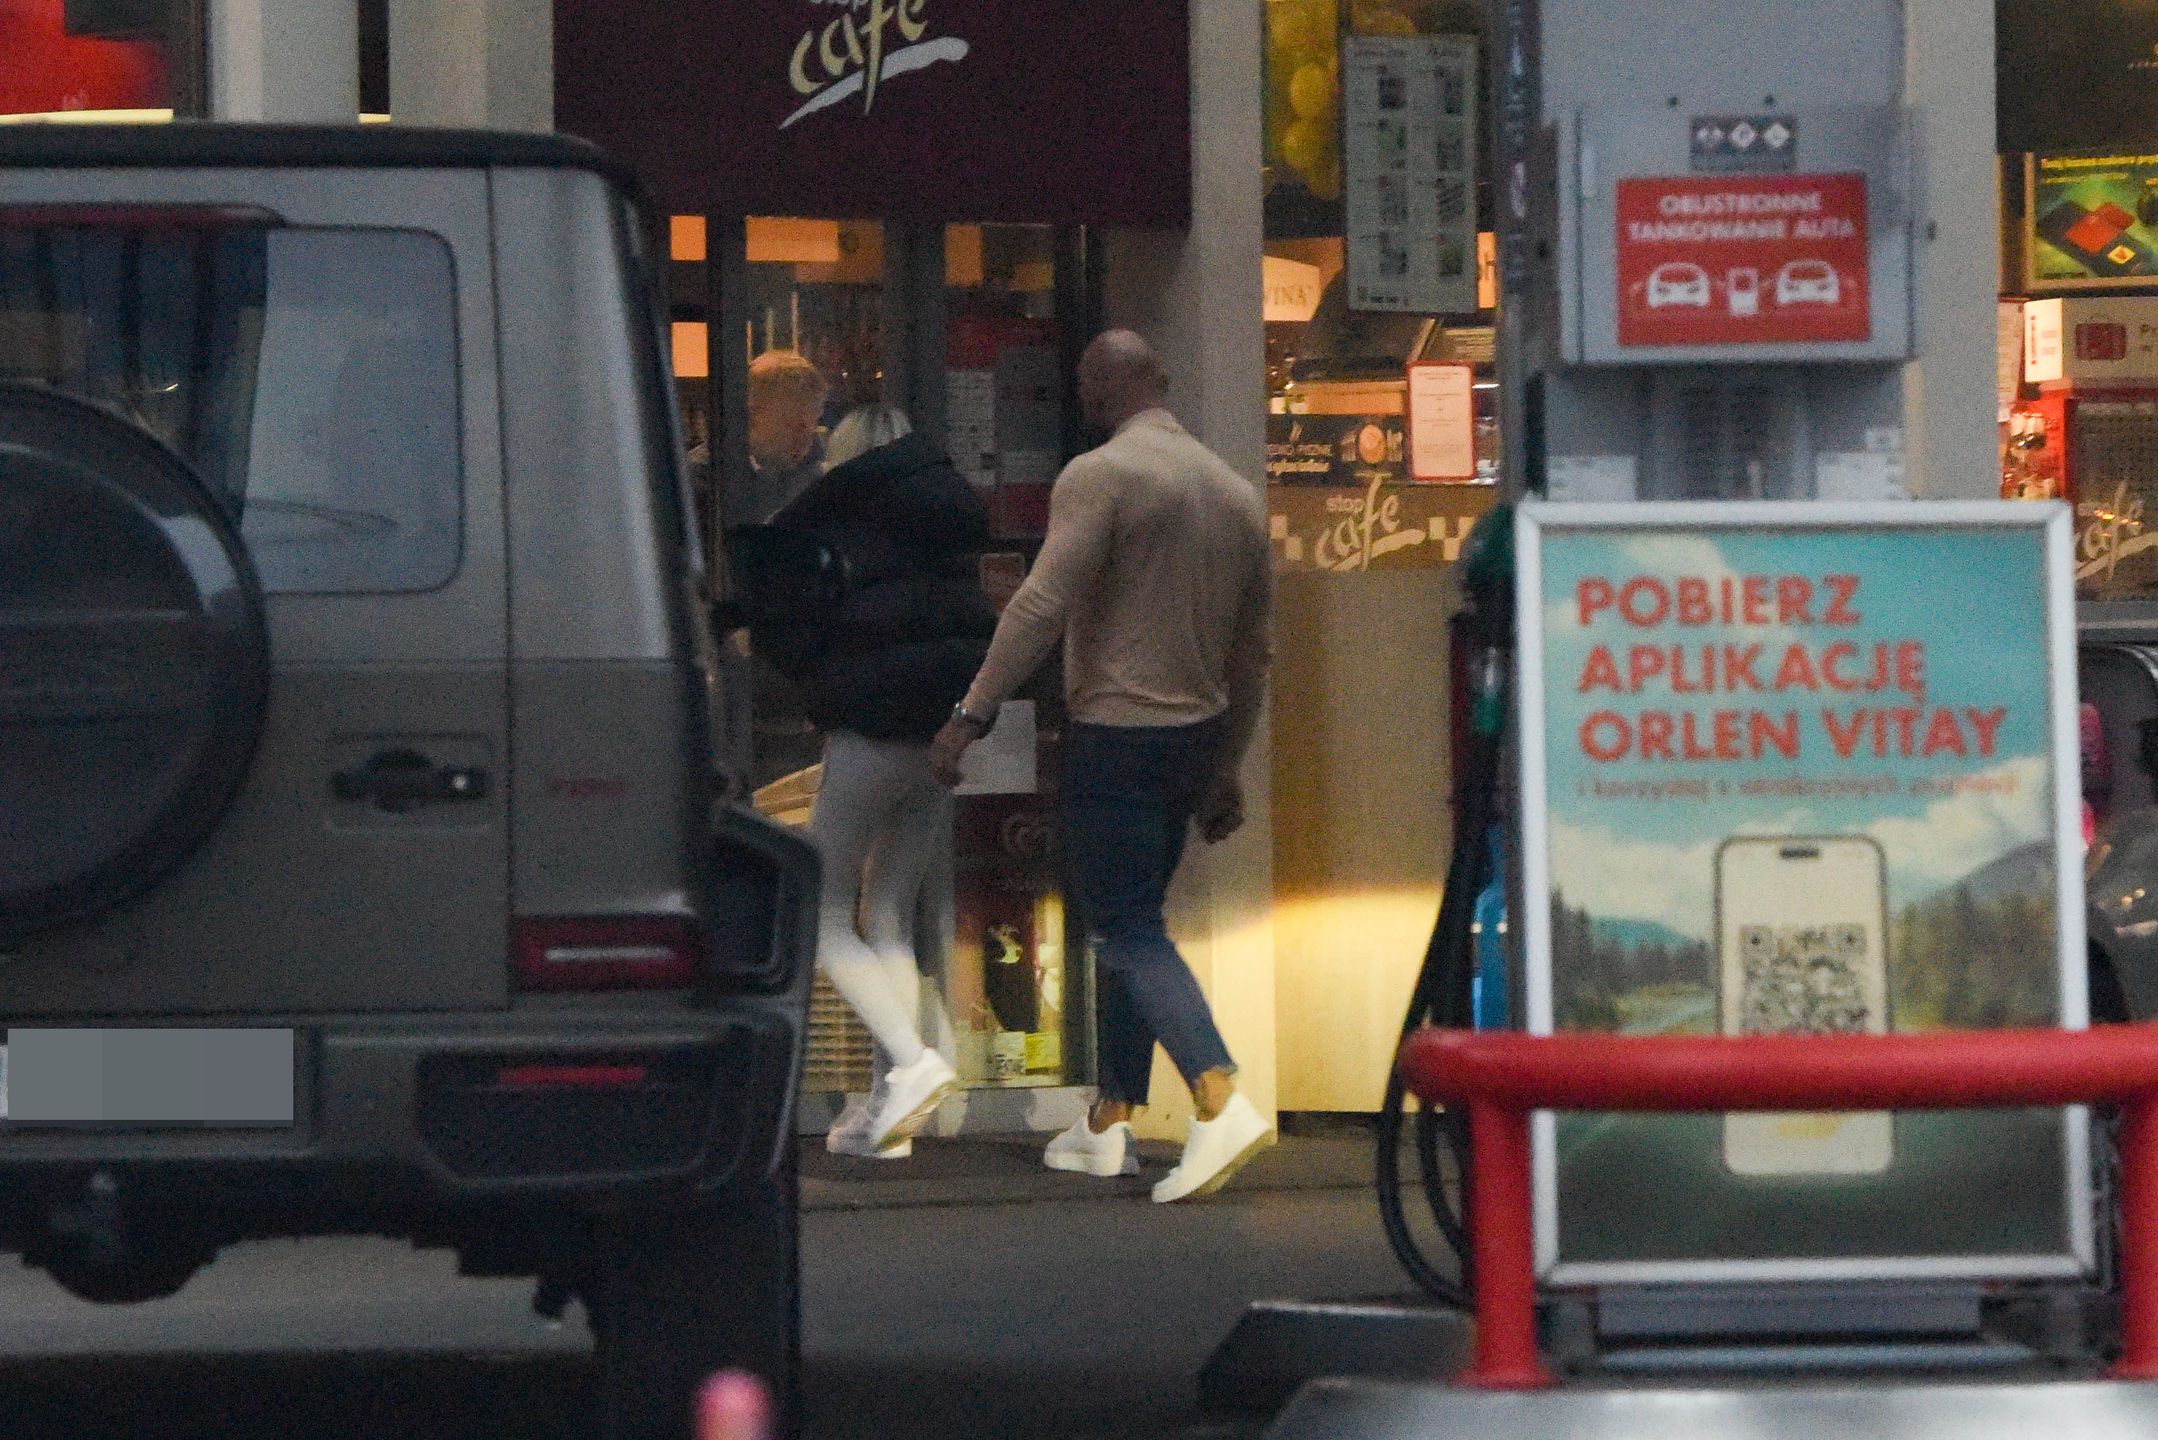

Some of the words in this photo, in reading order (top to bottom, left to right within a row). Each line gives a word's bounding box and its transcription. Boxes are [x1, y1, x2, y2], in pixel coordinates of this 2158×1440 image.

[1629, 220, 1786, 241] TANKOWANIE
[1793, 217, 1855, 239] AUTA
[1659, 193, 1822, 215] OBUSTRONNE
[1577, 575, 1861, 628] POBIERZ
[1578, 640, 1927, 703] APLIKACJĘ
[1578, 709, 1800, 762] ORLEN
[1822, 707, 2006, 758] VITAY
